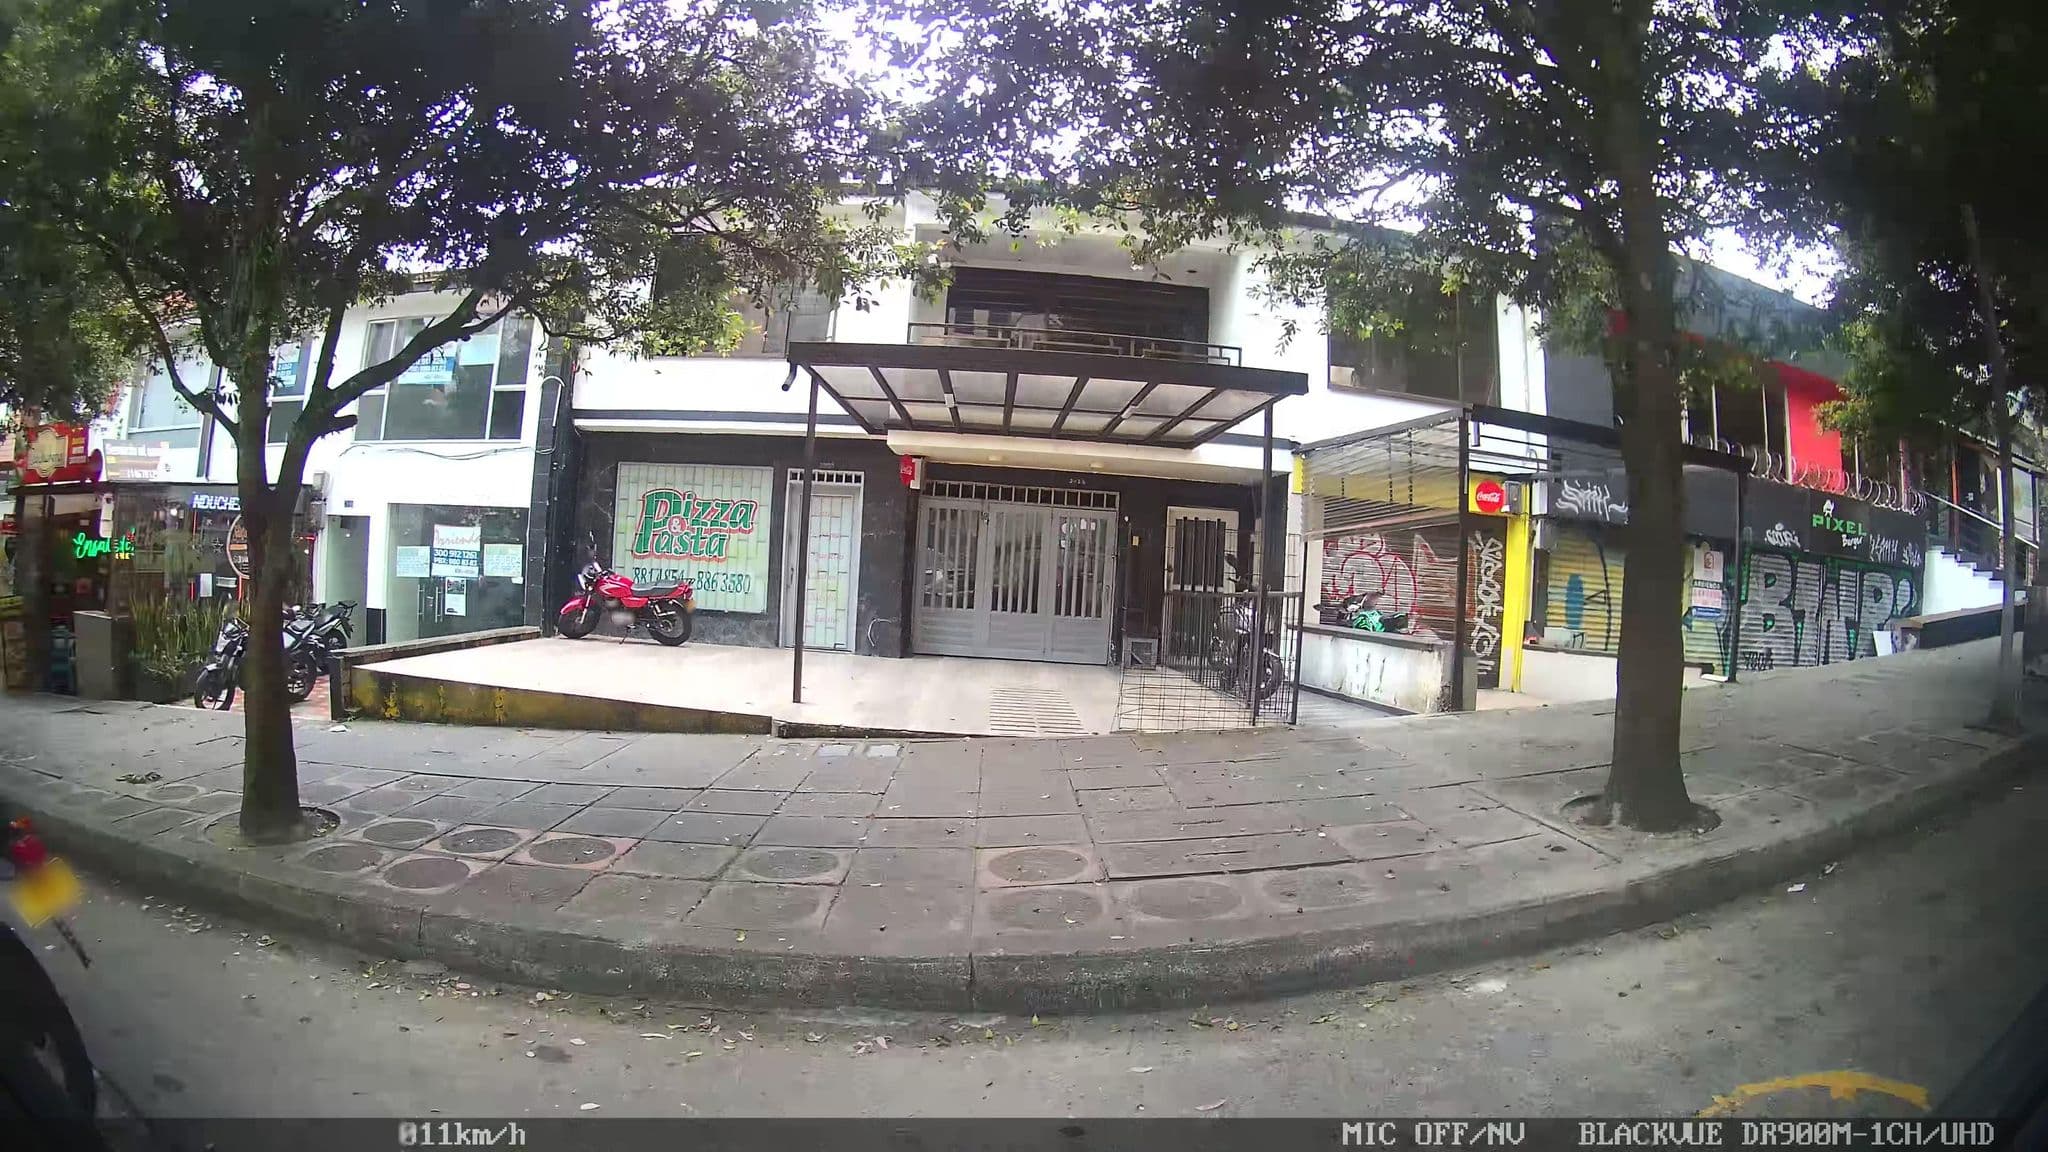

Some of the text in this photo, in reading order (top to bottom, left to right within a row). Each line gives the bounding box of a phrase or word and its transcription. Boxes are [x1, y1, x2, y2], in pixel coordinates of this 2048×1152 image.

[641, 488, 758, 534] Pizza
[667, 514, 688, 536] &
[1812, 513, 1867, 536] PIXEL
[632, 517, 730, 562] Pasta
[1841, 533, 1864, 550] Burger
